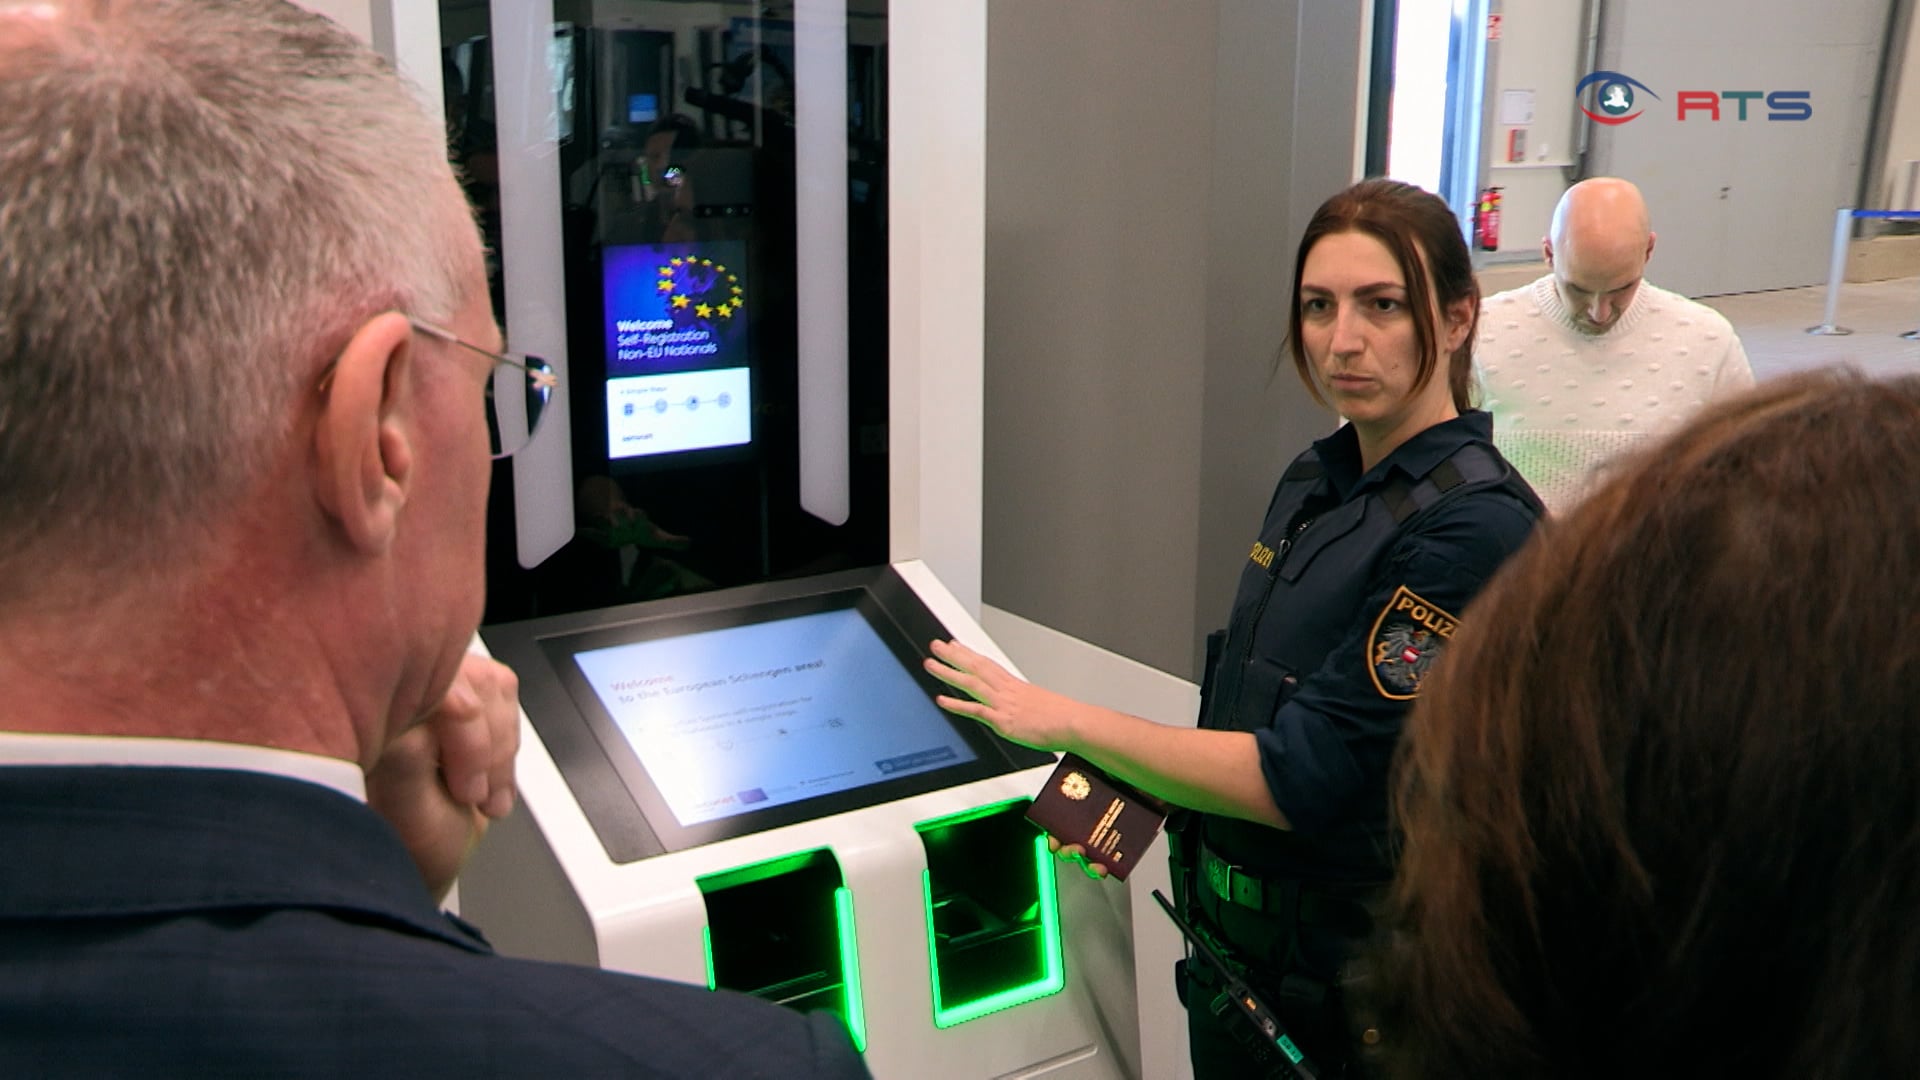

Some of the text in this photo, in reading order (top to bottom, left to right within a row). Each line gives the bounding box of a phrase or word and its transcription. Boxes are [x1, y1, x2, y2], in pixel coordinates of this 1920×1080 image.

[617, 319, 674, 332] Welcome
[617, 330, 710, 346] Self-Registration
[618, 342, 718, 360] Non-EU Nationals
[1395, 596, 1457, 640] POLIZ
[610, 674, 673, 691] Welcome
[618, 695, 635, 705] to
[637, 689, 660, 700] the
[662, 677, 727, 695] European
[728, 667, 792, 683] Schengen
